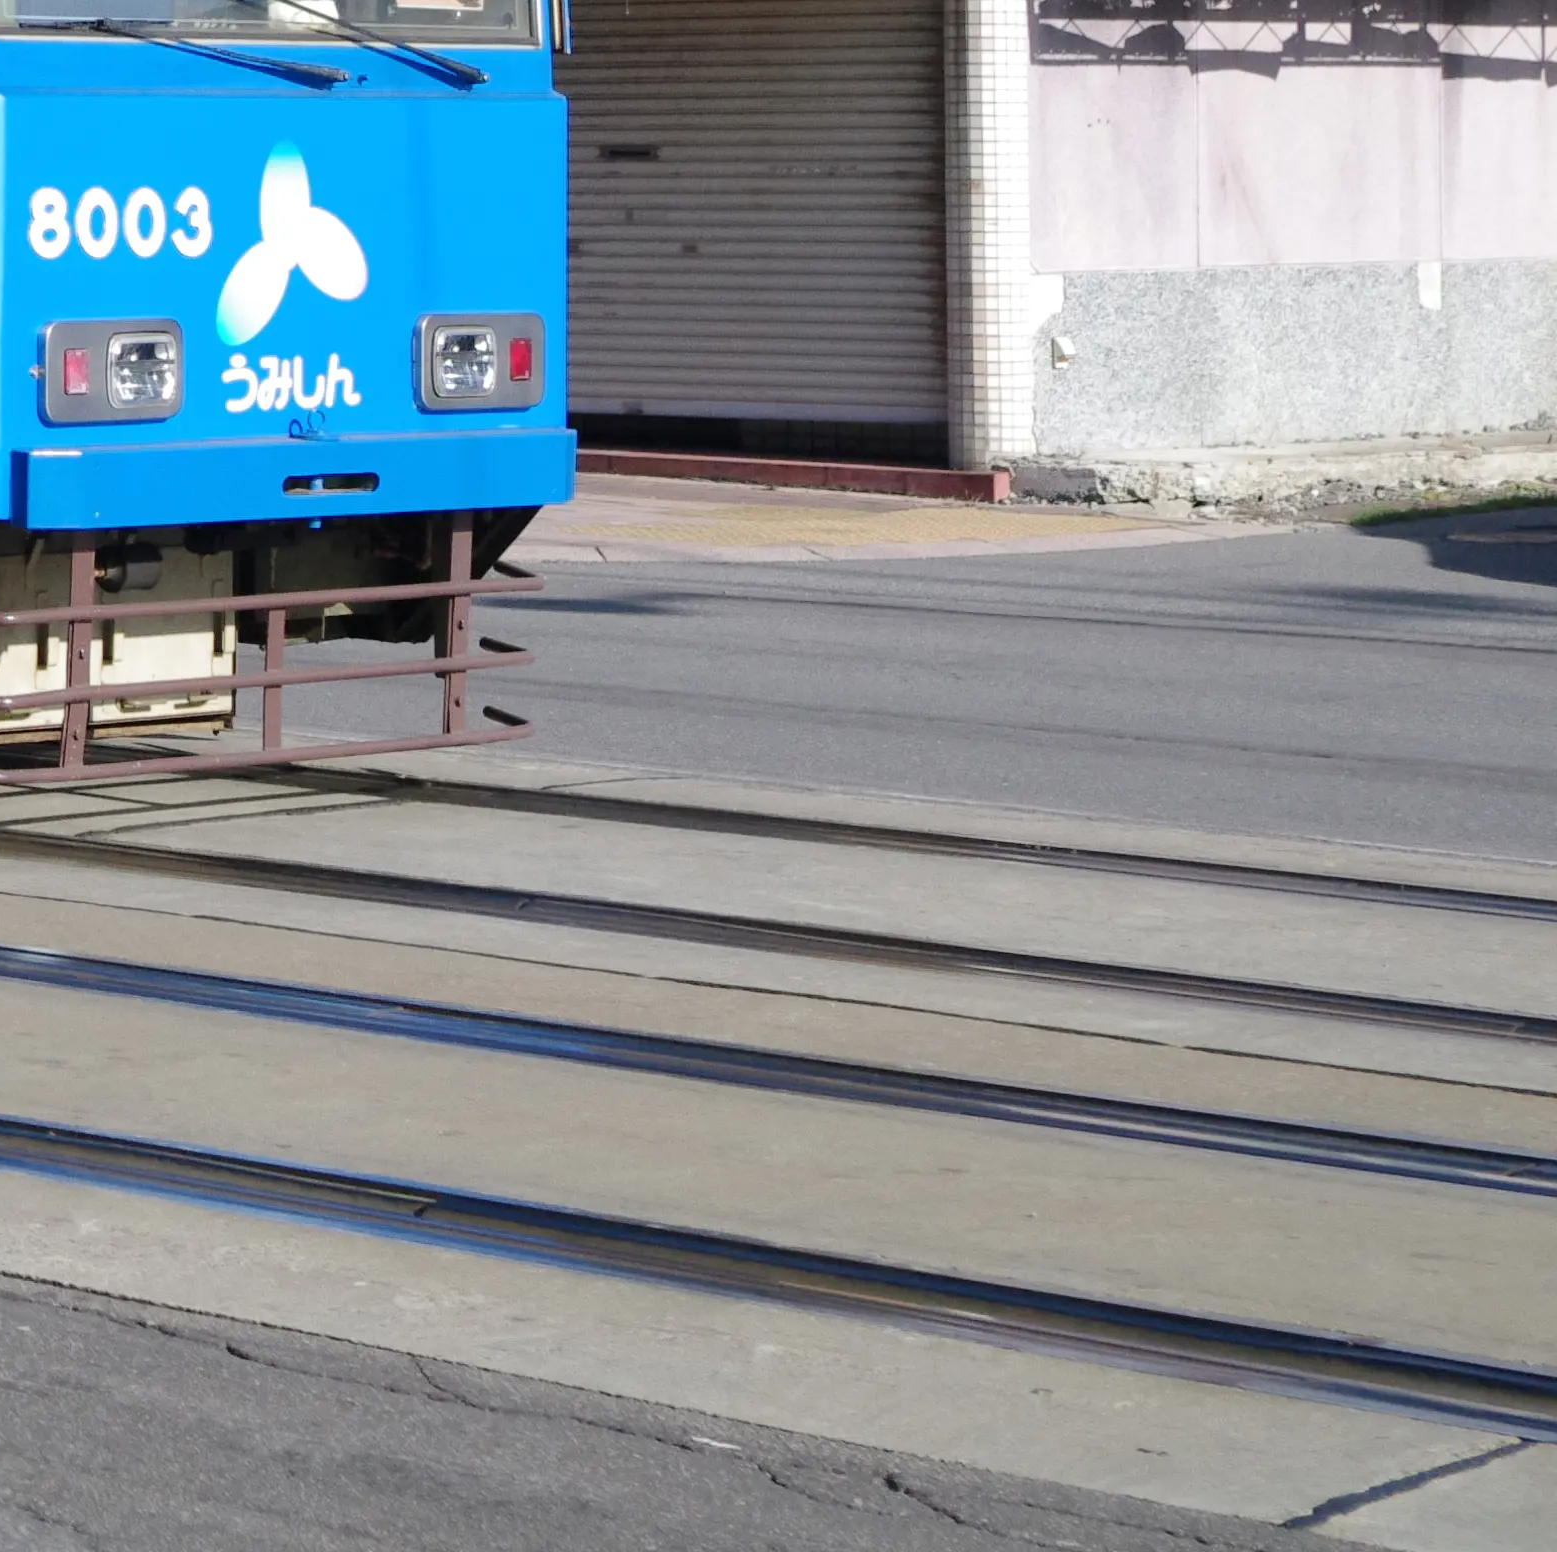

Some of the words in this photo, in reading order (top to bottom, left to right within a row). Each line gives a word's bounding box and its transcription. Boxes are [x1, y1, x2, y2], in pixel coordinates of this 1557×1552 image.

[27, 185, 213, 259] 8003
[220, 352, 362, 414] うみしん
